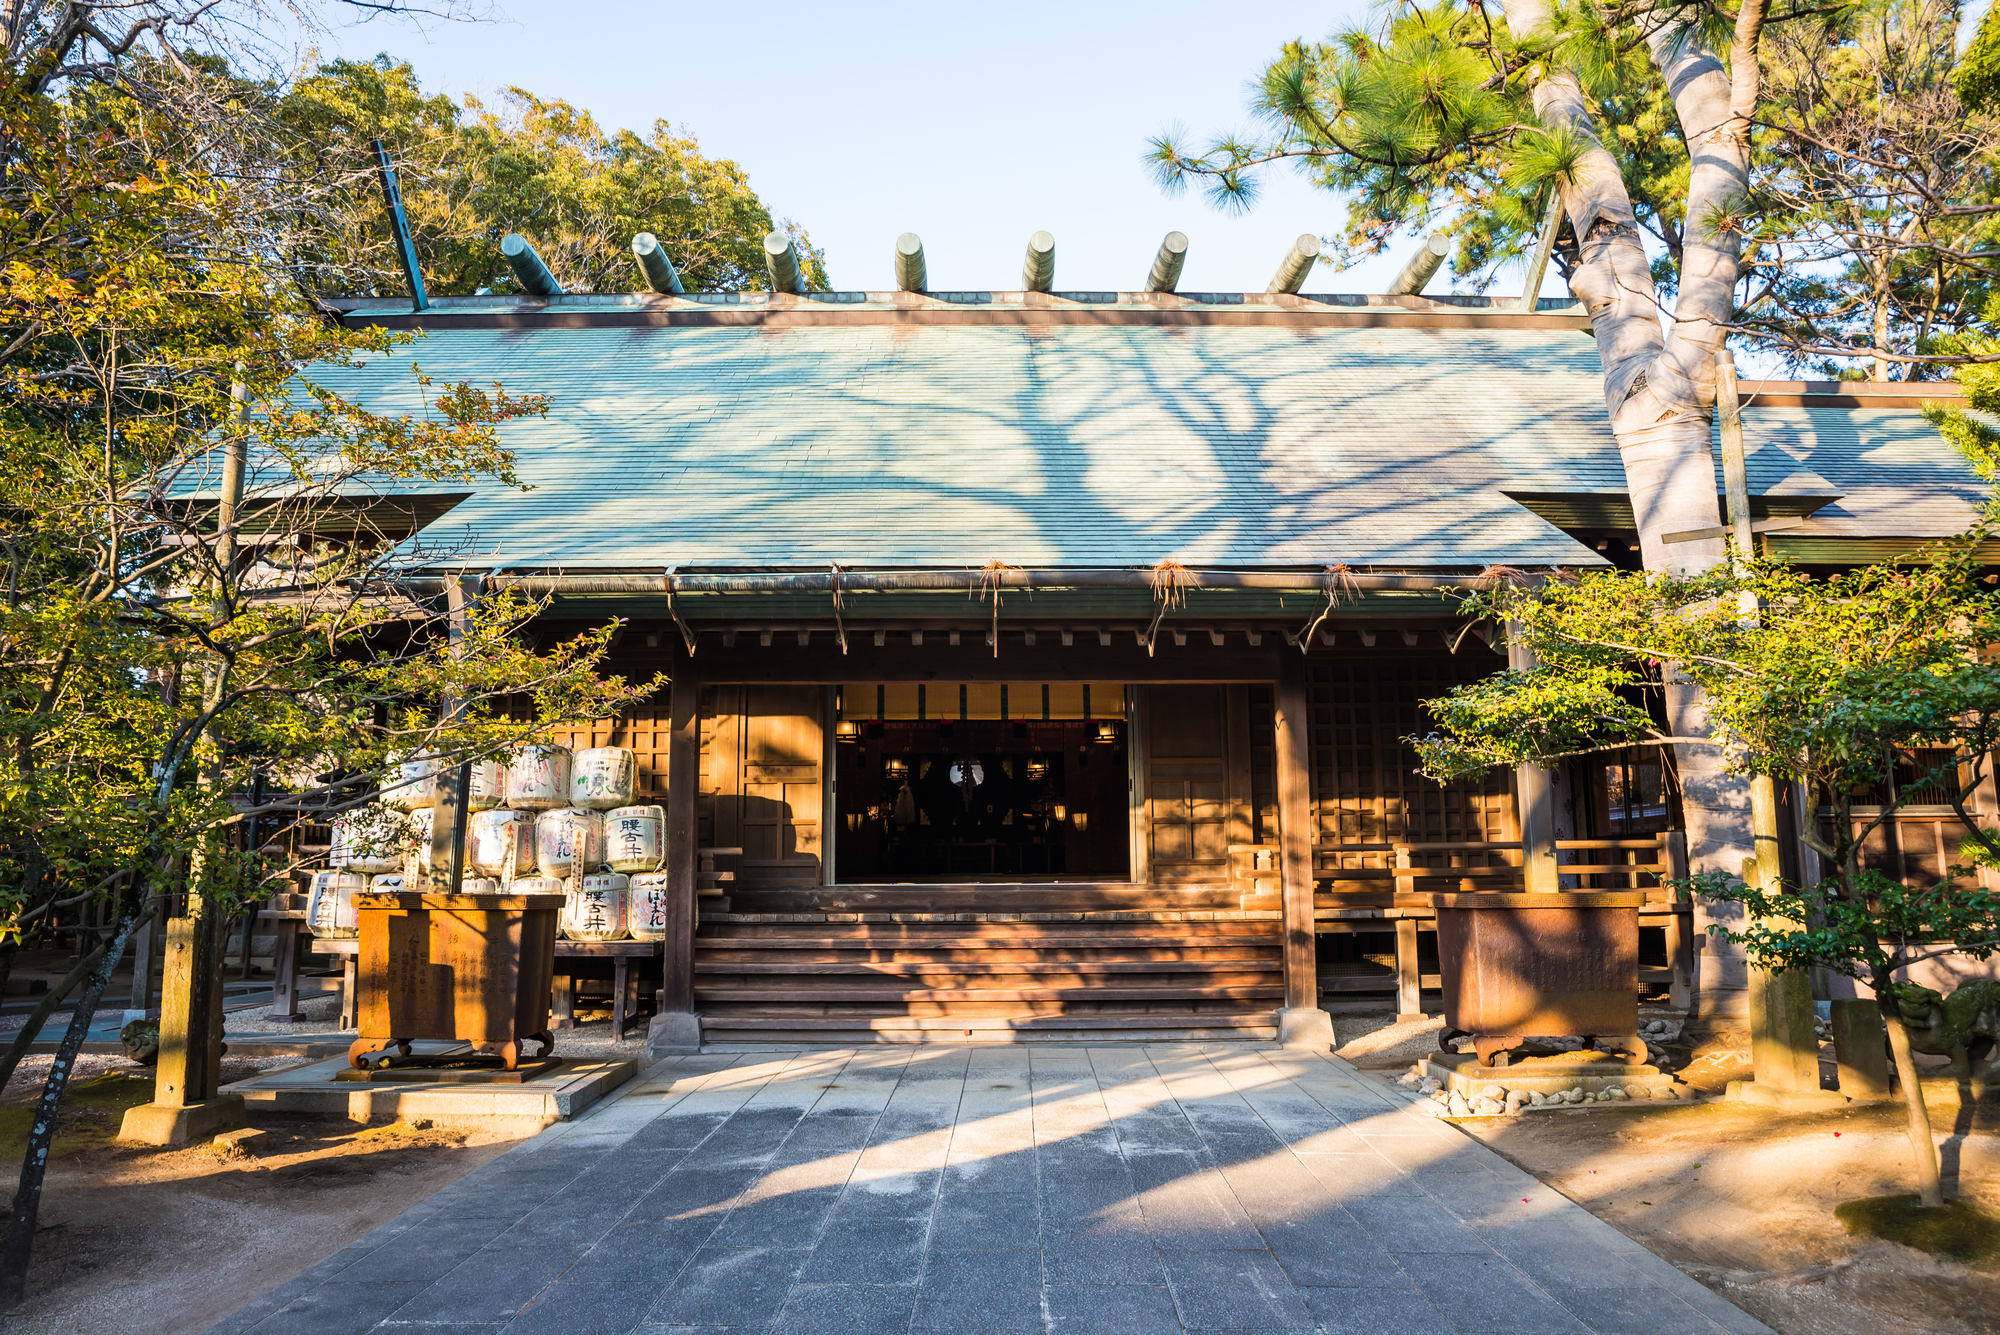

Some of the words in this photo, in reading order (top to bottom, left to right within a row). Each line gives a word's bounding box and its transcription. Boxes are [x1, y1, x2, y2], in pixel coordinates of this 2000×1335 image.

[619, 819, 644, 859] 腰古井
[582, 891, 608, 930] 腰古井
[648, 889, 664, 927] ほまれ
